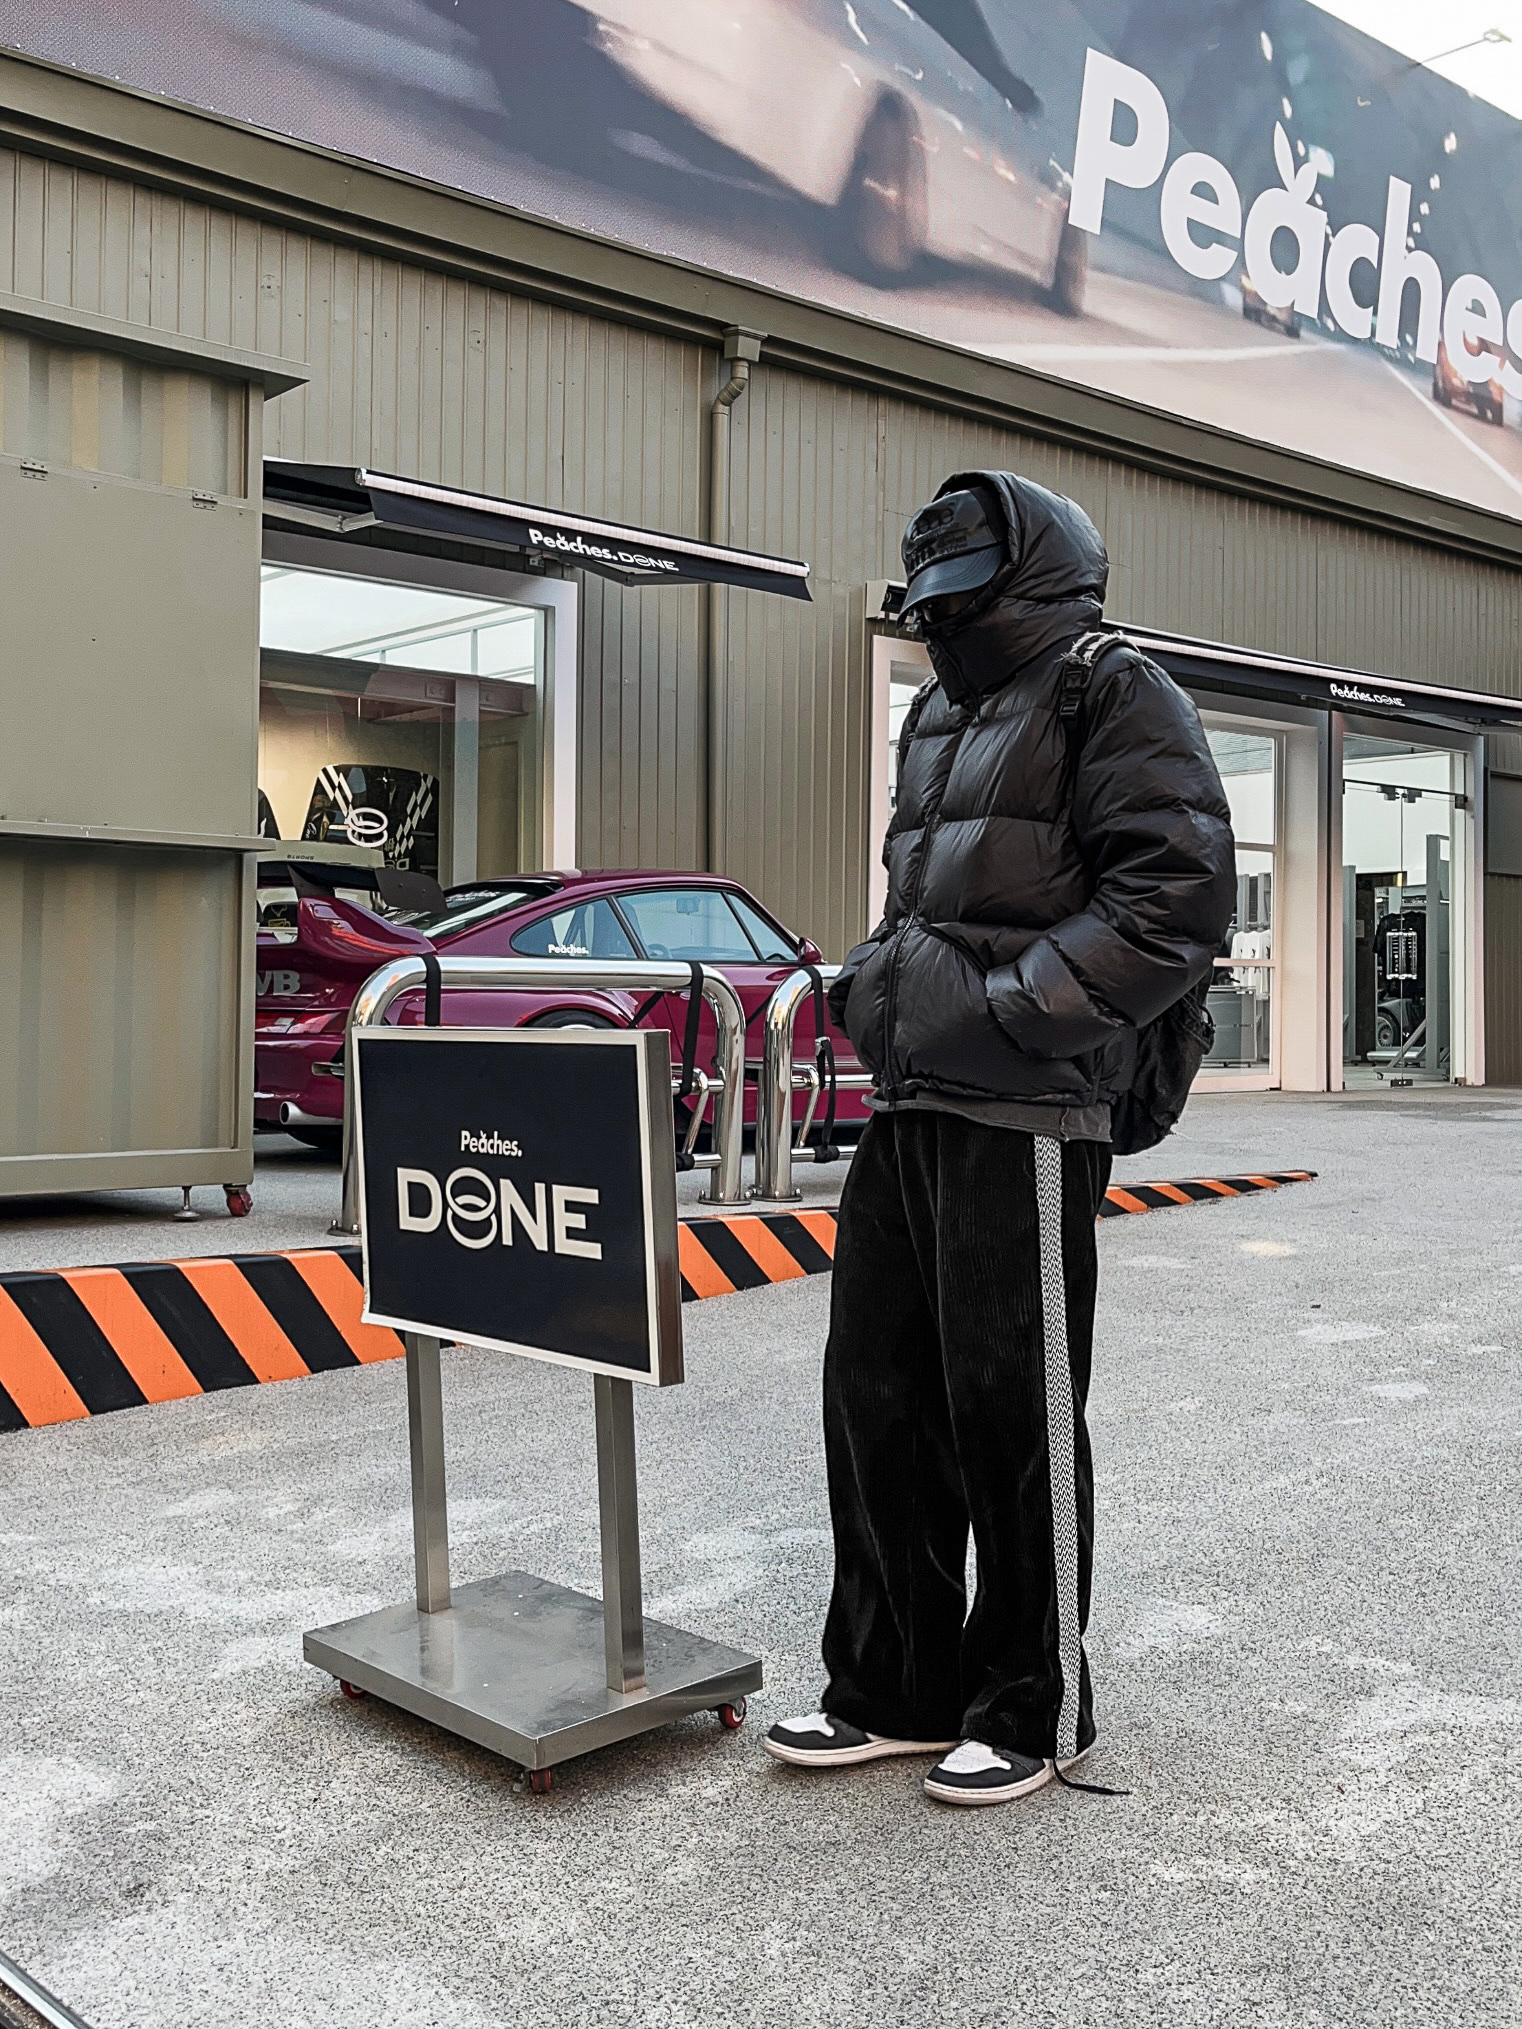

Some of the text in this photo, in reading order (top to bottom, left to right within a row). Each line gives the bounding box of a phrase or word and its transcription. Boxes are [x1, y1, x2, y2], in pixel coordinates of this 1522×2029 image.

[528, 528, 618, 560] Peaches.
[1330, 683, 1374, 702] Peaches.
[548, 944, 589, 955] Peaches.
[460, 1130, 523, 1158] Peaches.
[397, 1167, 602, 1260] DONE
